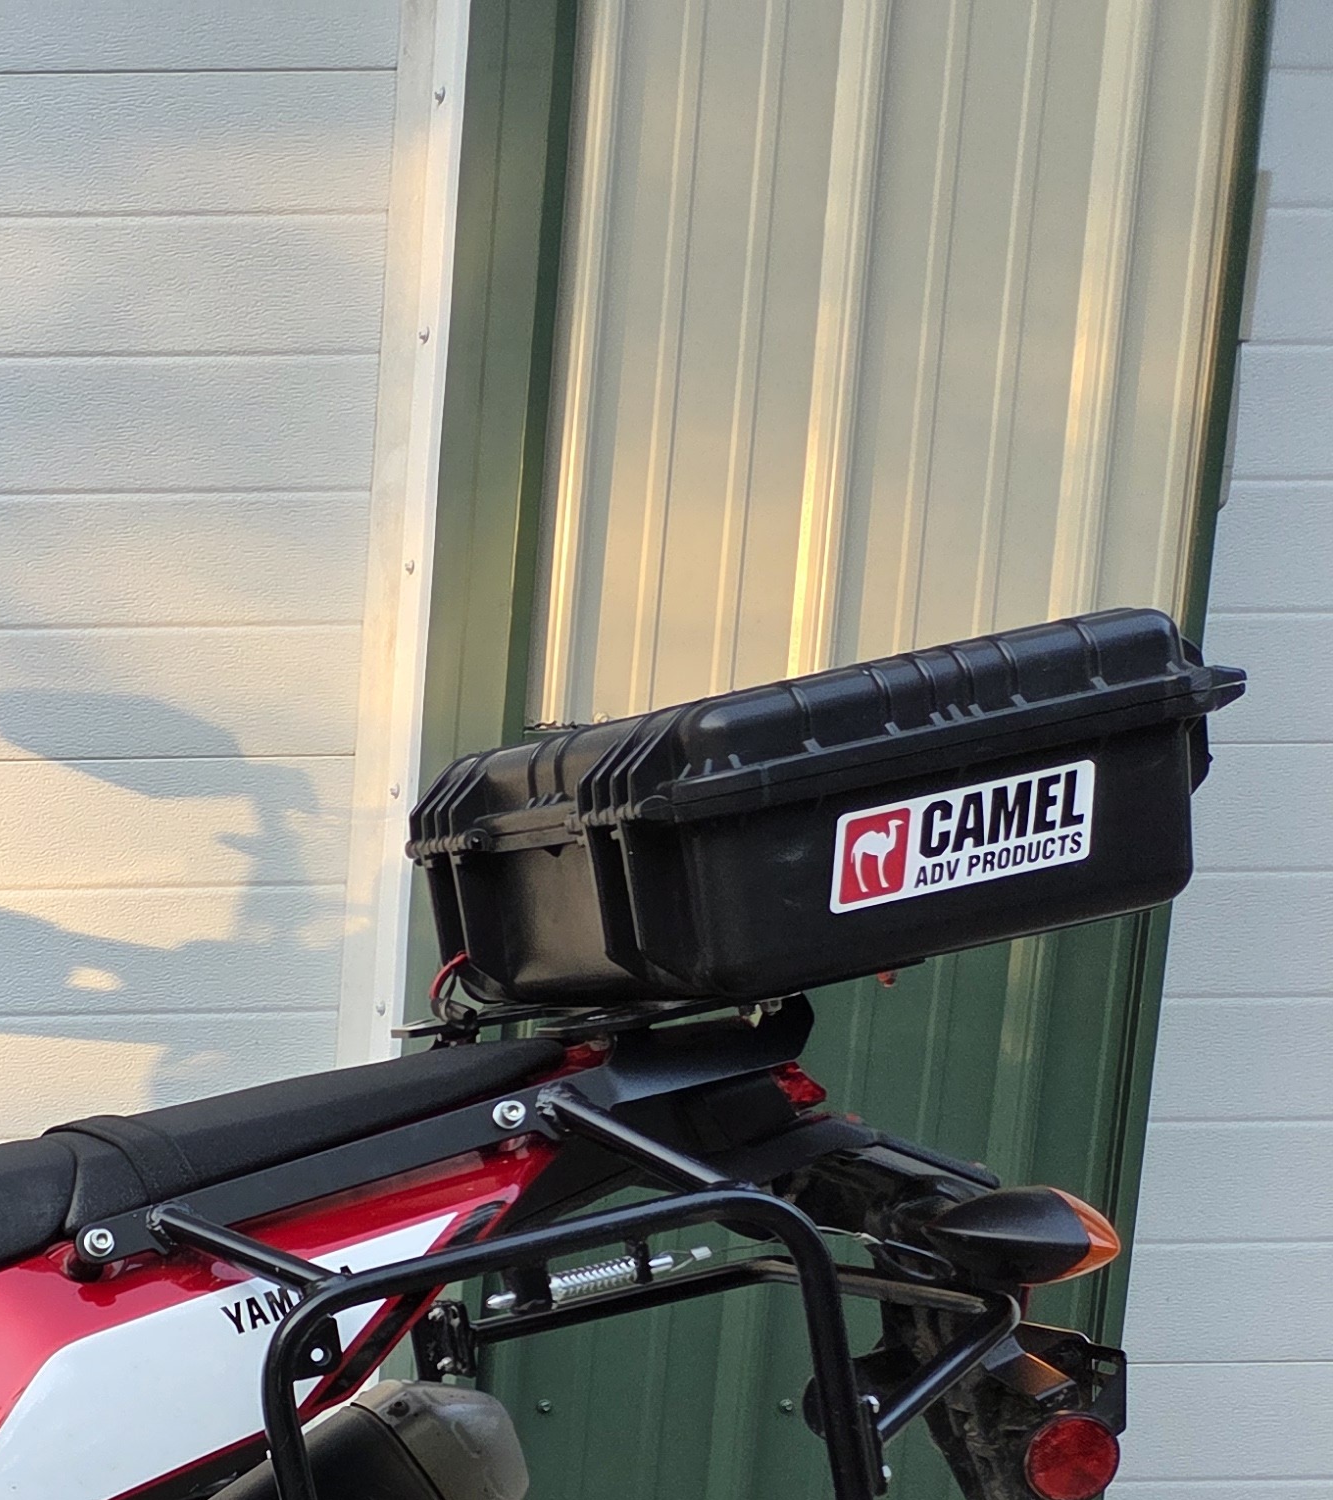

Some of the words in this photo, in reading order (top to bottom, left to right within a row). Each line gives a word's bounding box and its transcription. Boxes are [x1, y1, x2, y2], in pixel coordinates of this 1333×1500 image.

[919, 769, 1085, 859] CAMEL
[914, 857, 960, 889] ADV
[966, 831, 1083, 877] PRODUCTS
